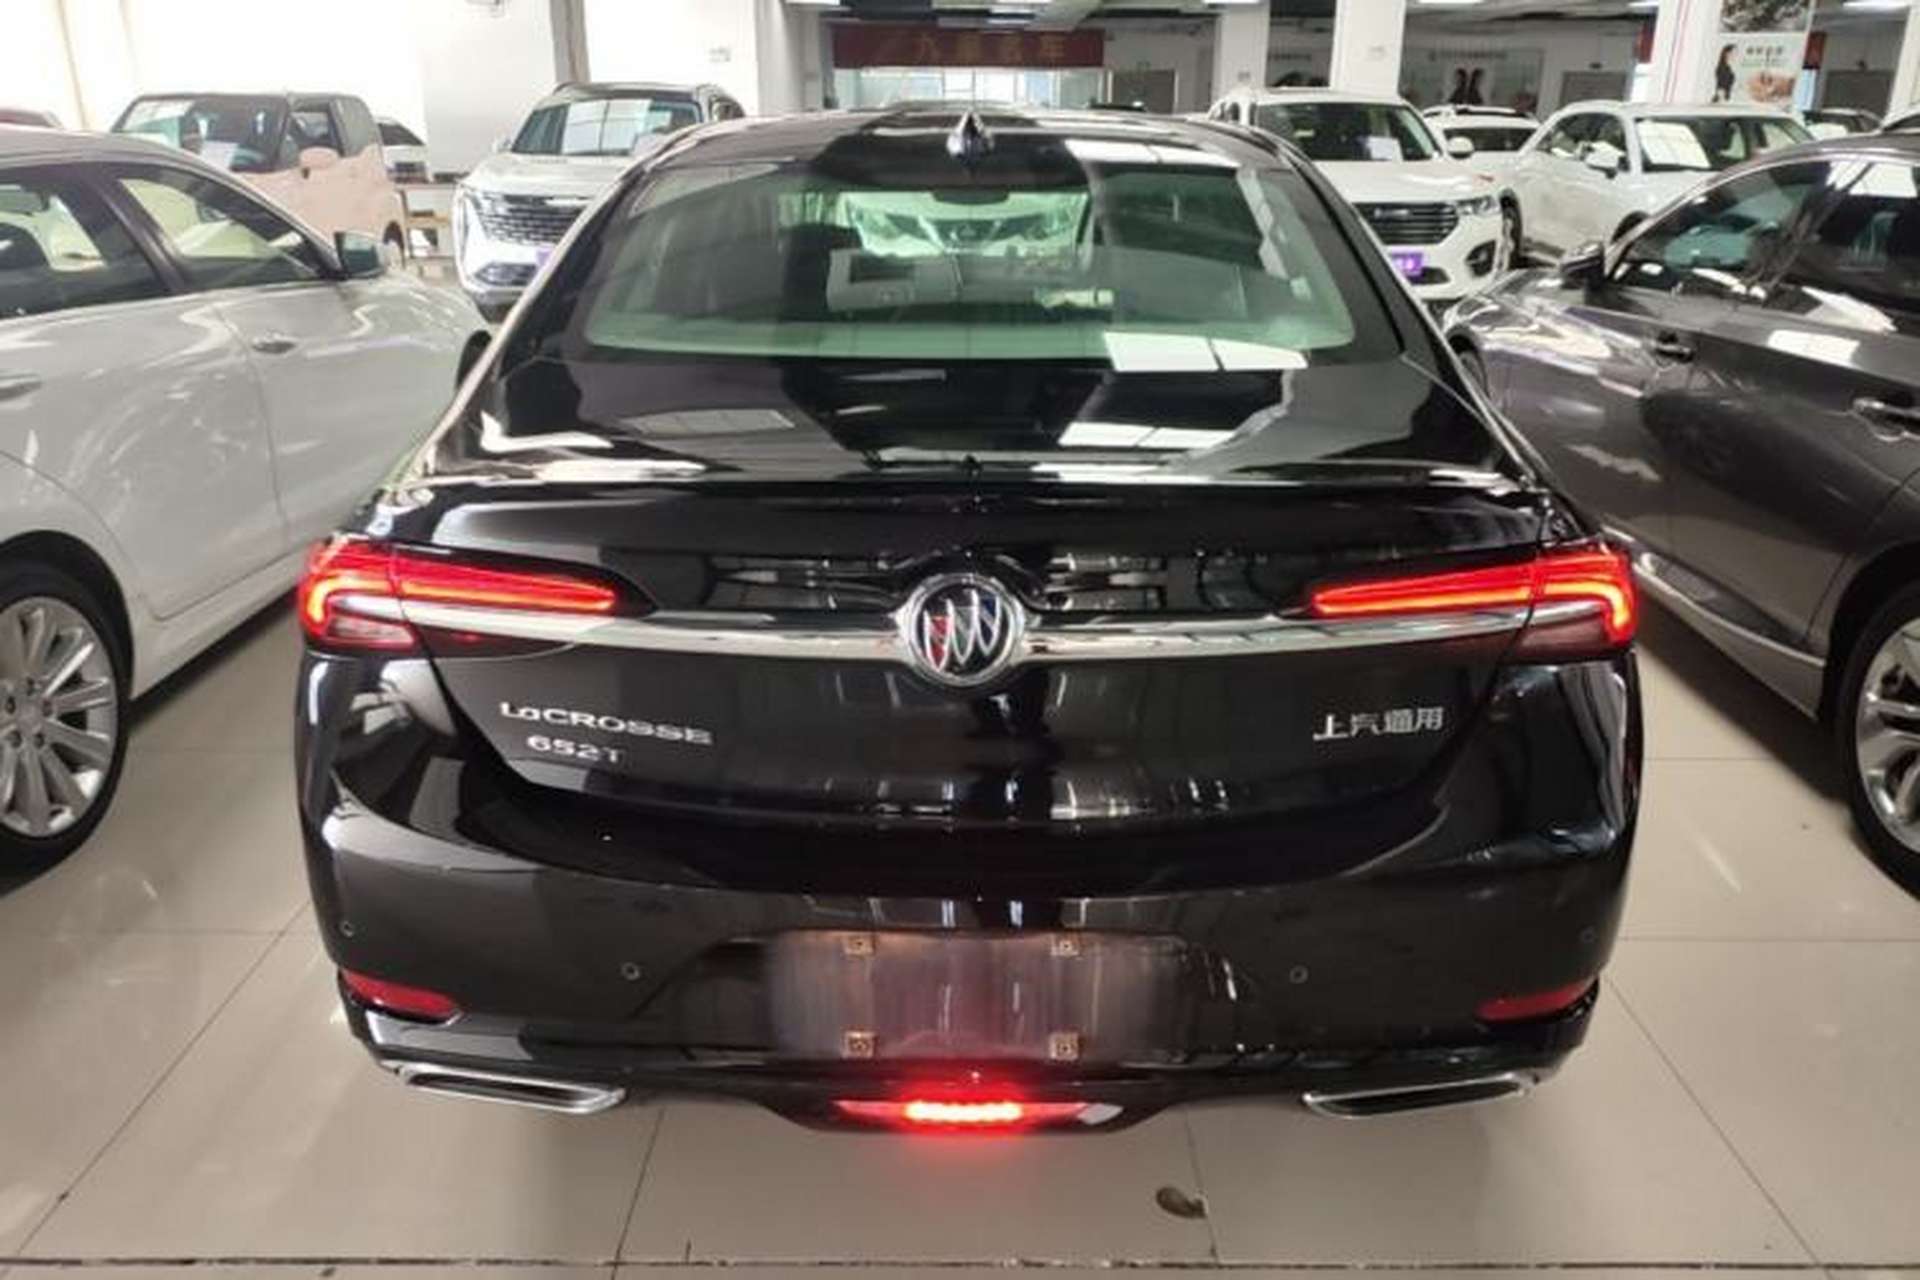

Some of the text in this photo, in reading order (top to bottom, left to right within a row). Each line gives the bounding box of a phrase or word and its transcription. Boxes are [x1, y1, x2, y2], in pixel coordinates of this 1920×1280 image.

[500, 701, 712, 745] LaCROSSE
[1312, 706, 1444, 741] 上汽通用
[527, 734, 621, 763] 652T
